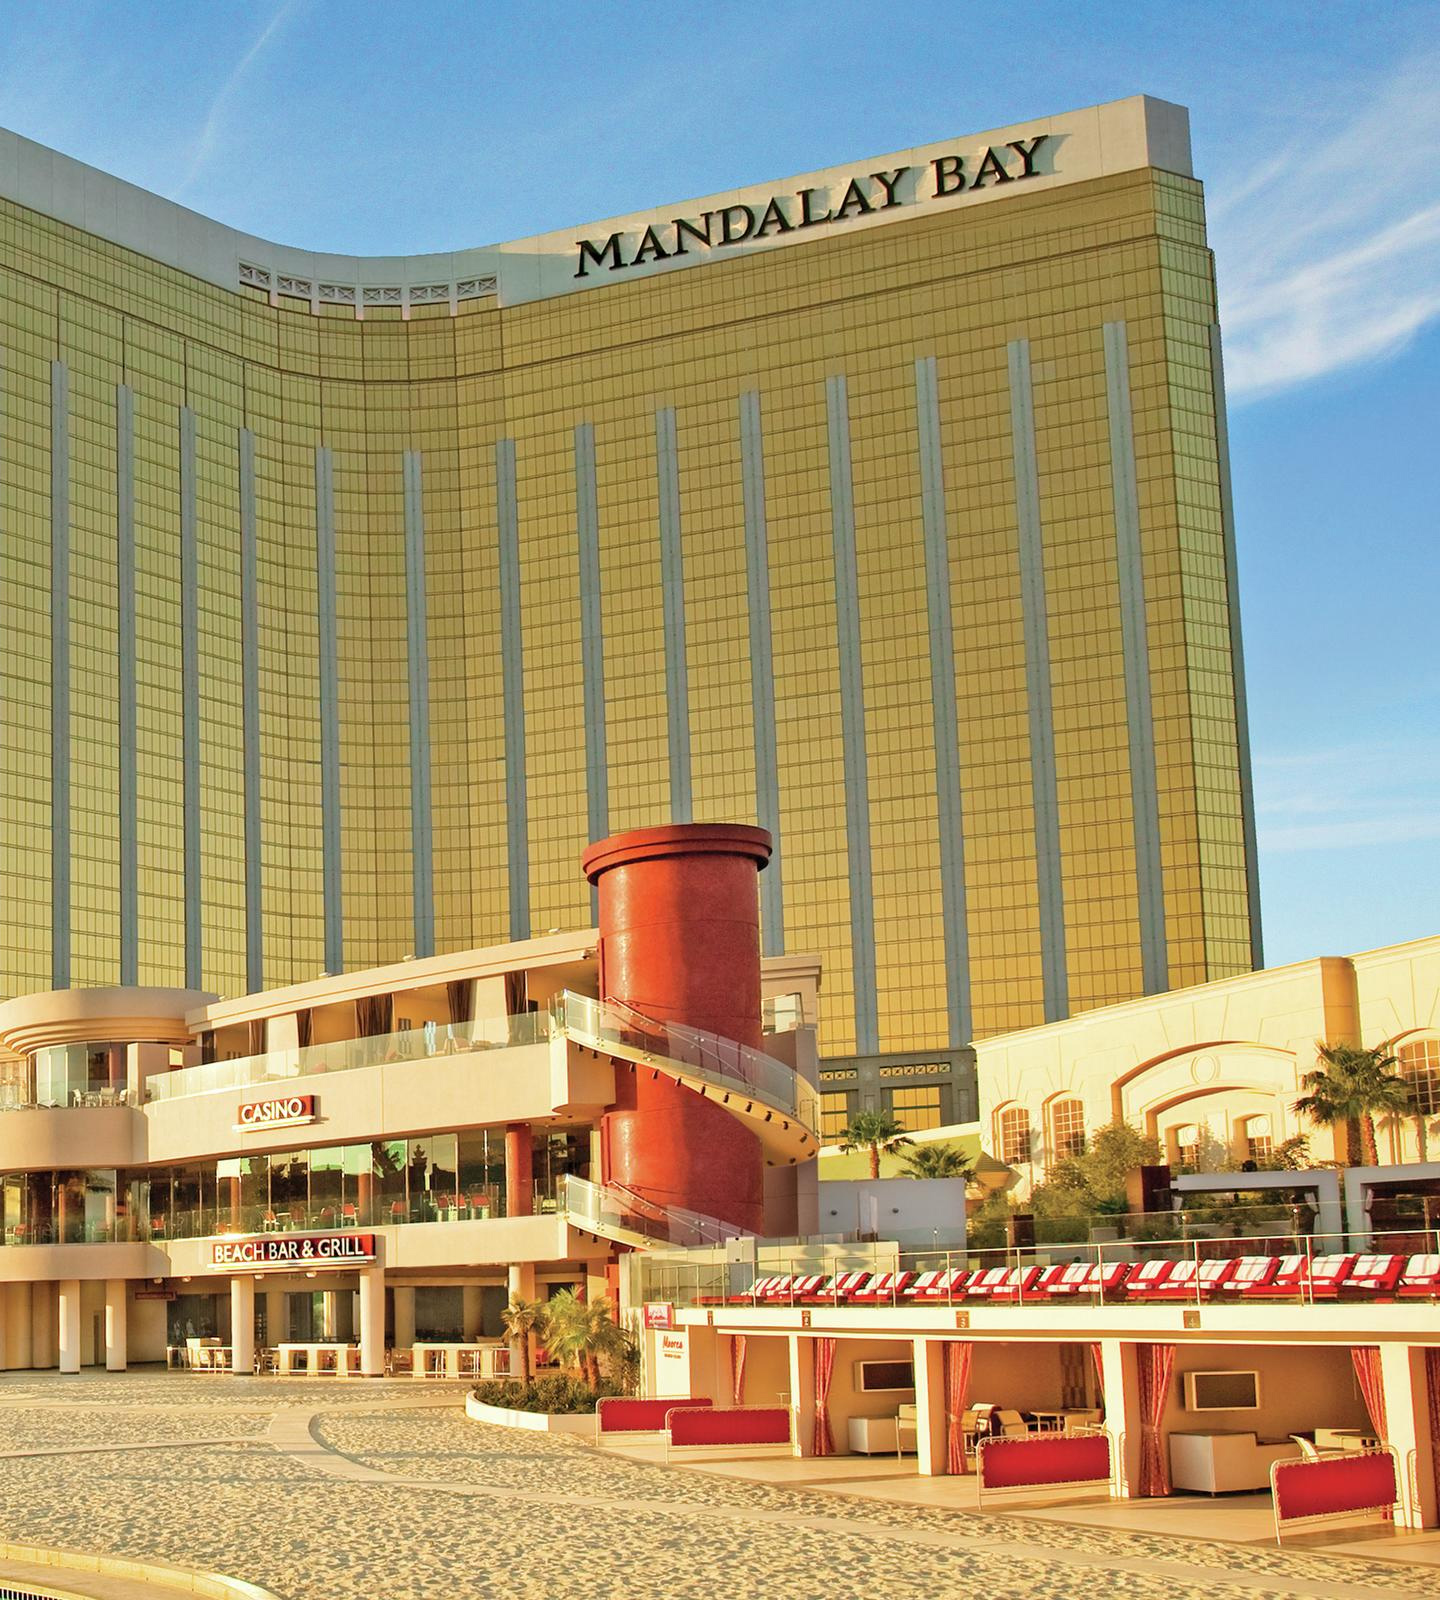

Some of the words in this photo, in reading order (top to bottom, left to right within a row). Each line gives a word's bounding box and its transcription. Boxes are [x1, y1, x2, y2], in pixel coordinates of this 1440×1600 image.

[573, 165, 911, 278] MANDALAY
[930, 135, 1049, 199] BAY
[241, 1097, 303, 1123] CASINO
[215, 1242, 265, 1263] BEACH
[268, 1241, 300, 1260] BAR
[302, 1239, 313, 1257] &
[318, 1236, 364, 1256] GRILL
[960, 1317, 966, 1328] 3
